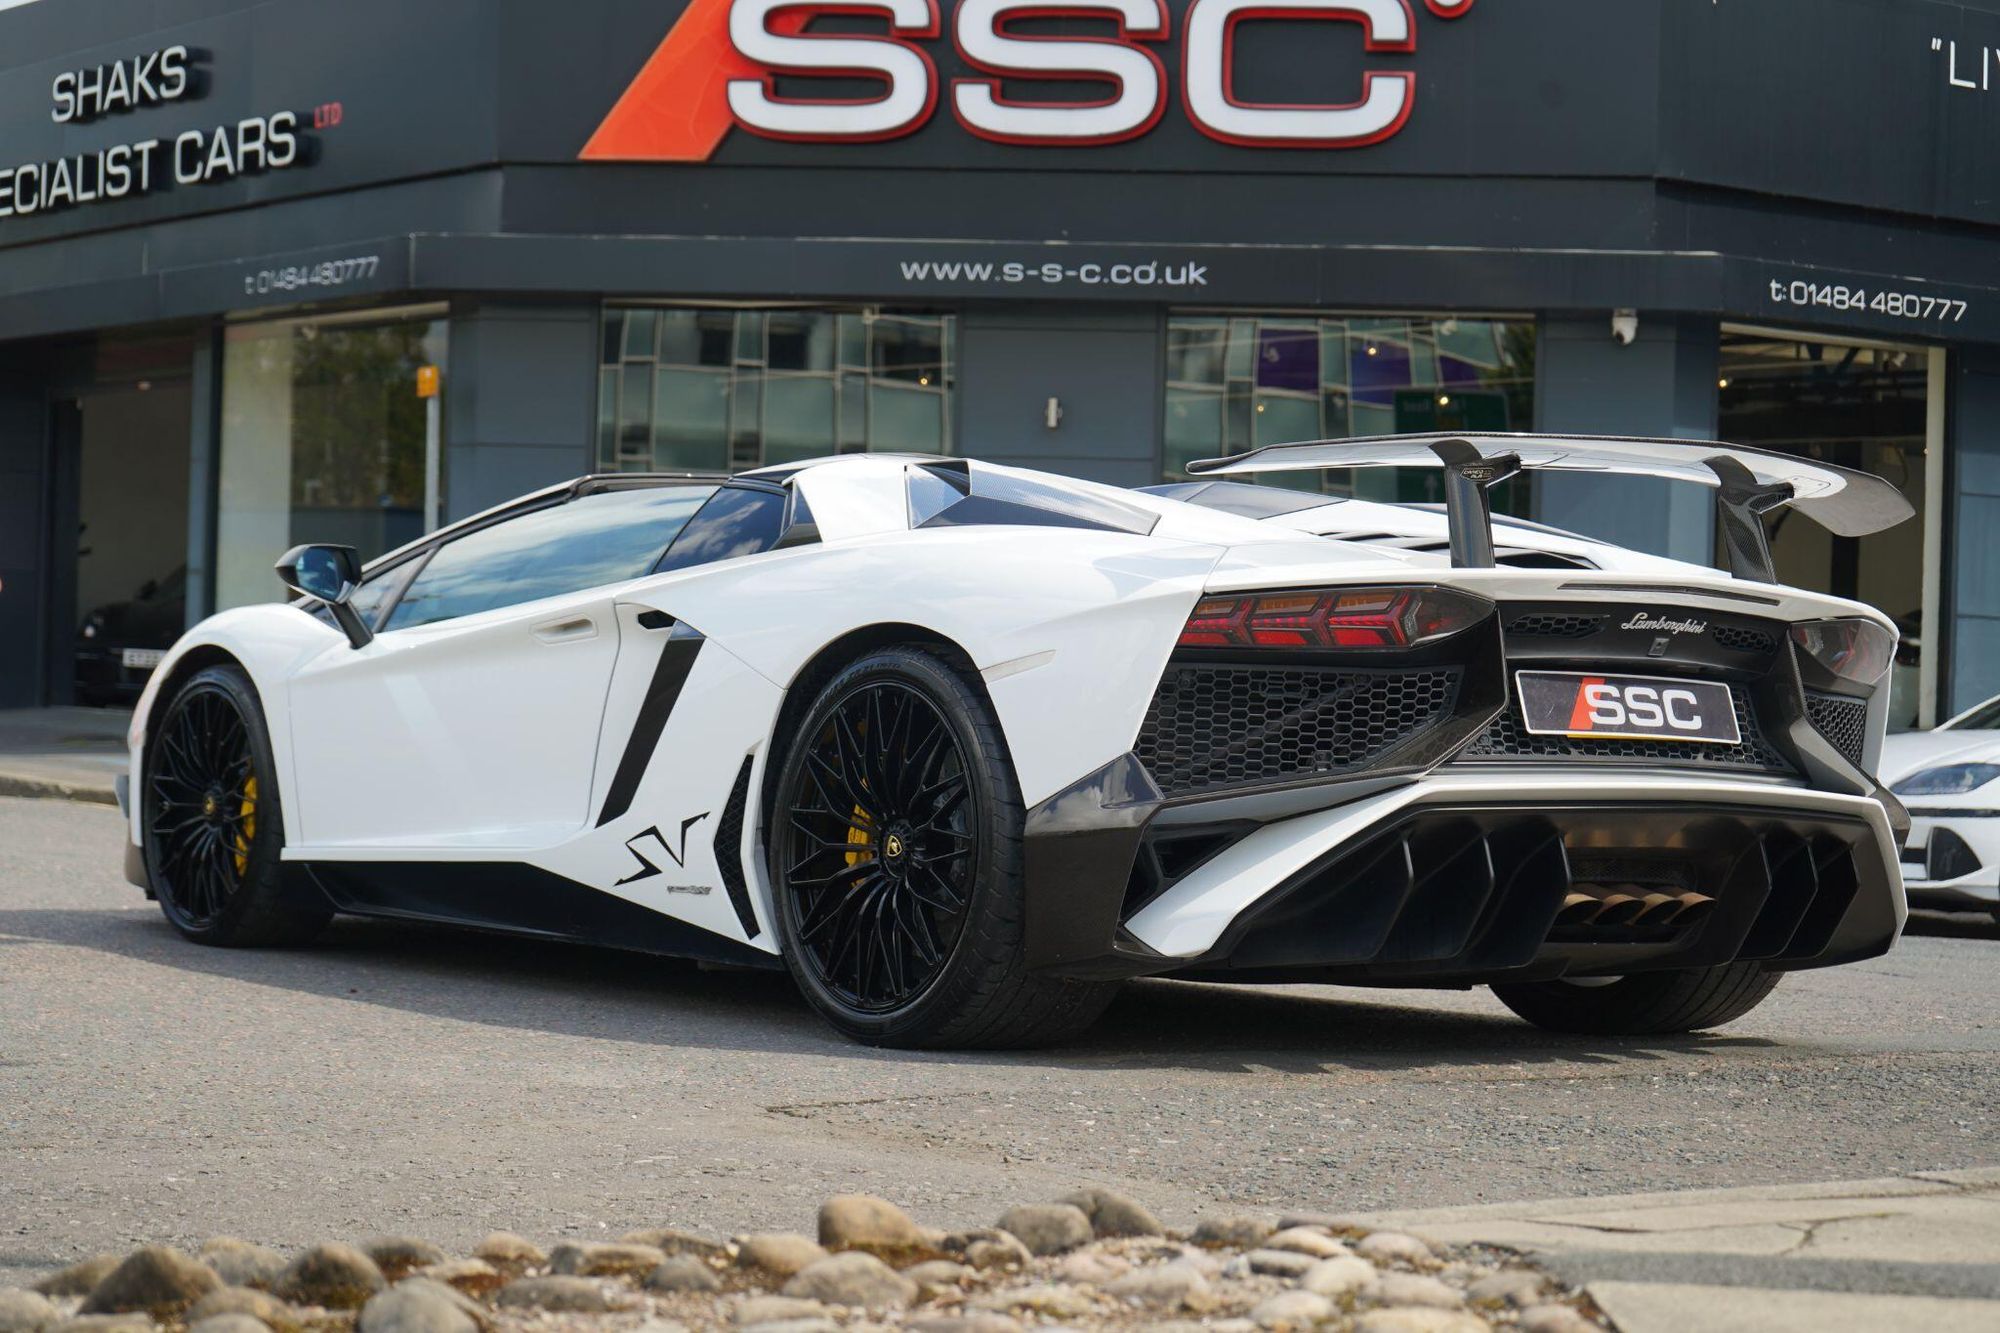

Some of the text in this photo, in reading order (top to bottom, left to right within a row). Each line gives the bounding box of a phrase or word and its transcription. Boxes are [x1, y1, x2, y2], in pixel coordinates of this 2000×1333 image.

[51, 45, 188, 123] SHAKS
[725, 0, 1416, 148] SSC
[1931, 37, 2000, 91] "LI
[0, 102, 343, 217] ECIALIST CARS LTD
[900, 260, 1208, 285] www.s-s-c.co.uk
[1870, 291, 1968, 322] 480777
[1621, 611, 1707, 635] Lamborghini
[1584, 684, 1703, 730] SSC
